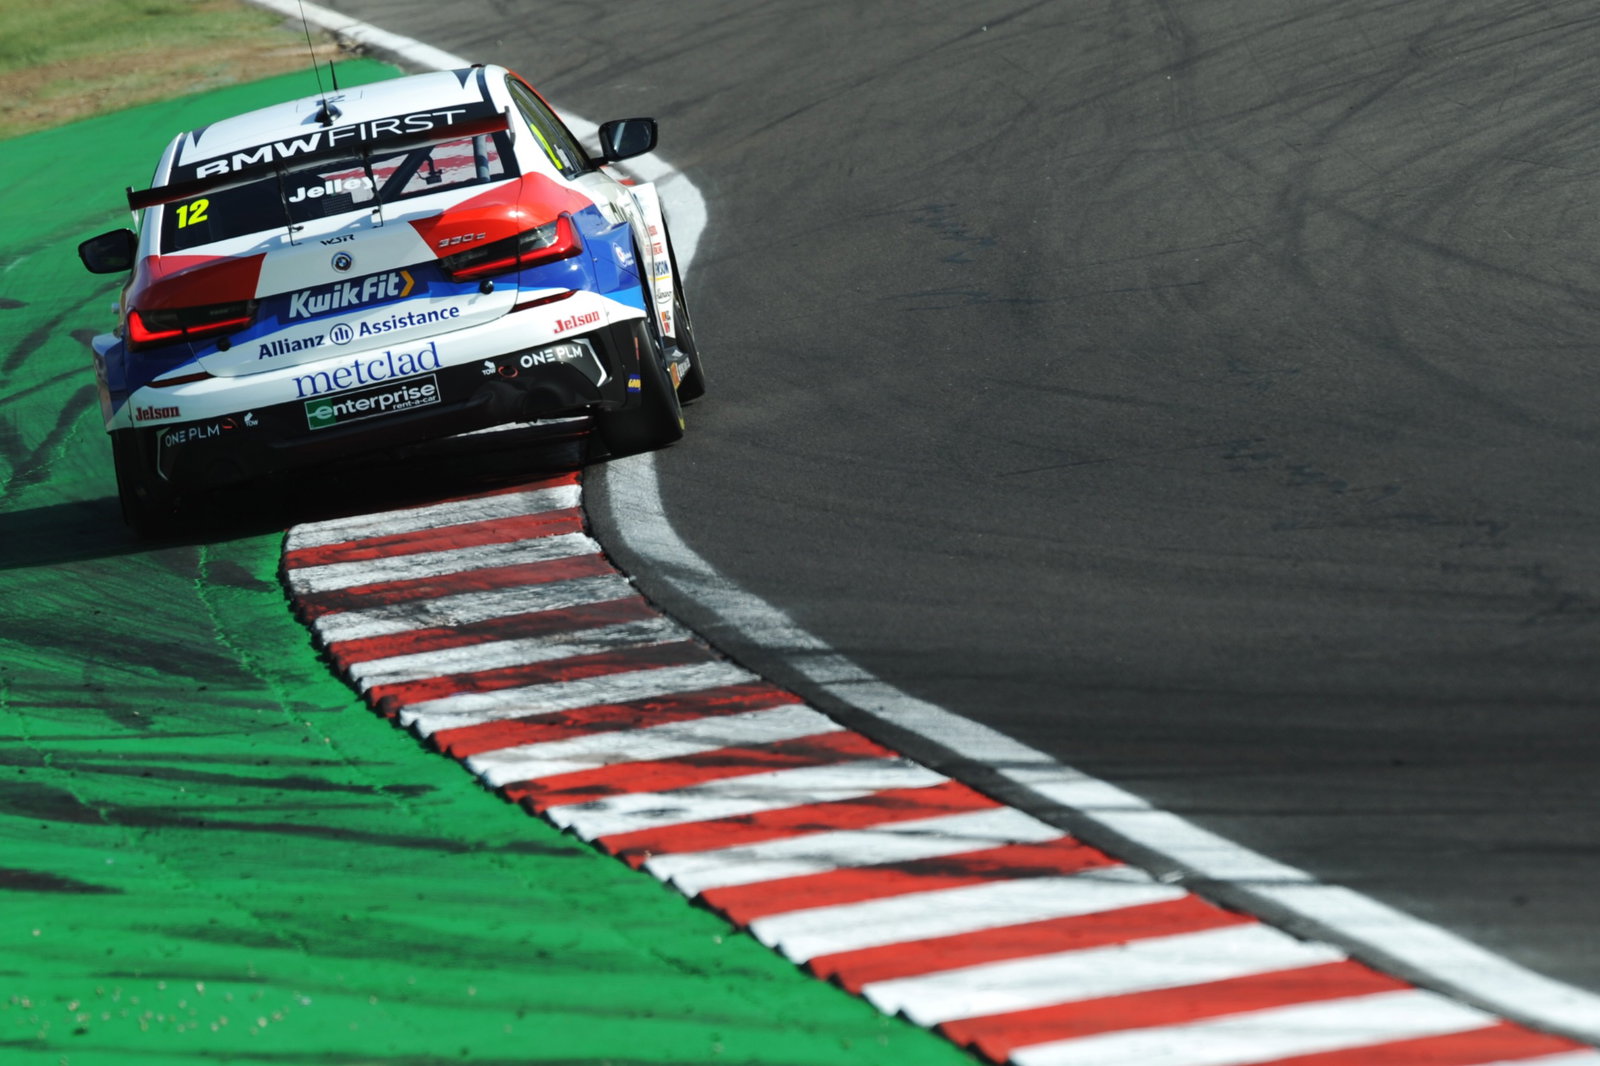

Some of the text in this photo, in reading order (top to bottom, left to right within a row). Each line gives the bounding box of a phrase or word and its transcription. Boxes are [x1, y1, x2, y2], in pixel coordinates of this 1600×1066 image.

[288, 174, 380, 203] Jelley
[175, 198, 209, 229] 12
[258, 306, 460, 360] Allianz Assistance
[553, 311, 600, 334] Jelson
[292, 341, 443, 398] metclad
[520, 345, 583, 368] ONE PLM
[135, 405, 181, 421] Jelson
[312, 383, 436, 420] enterprise
[392, 395, 437, 411] rent-a-car
[165, 423, 220, 447] ONE PLM
